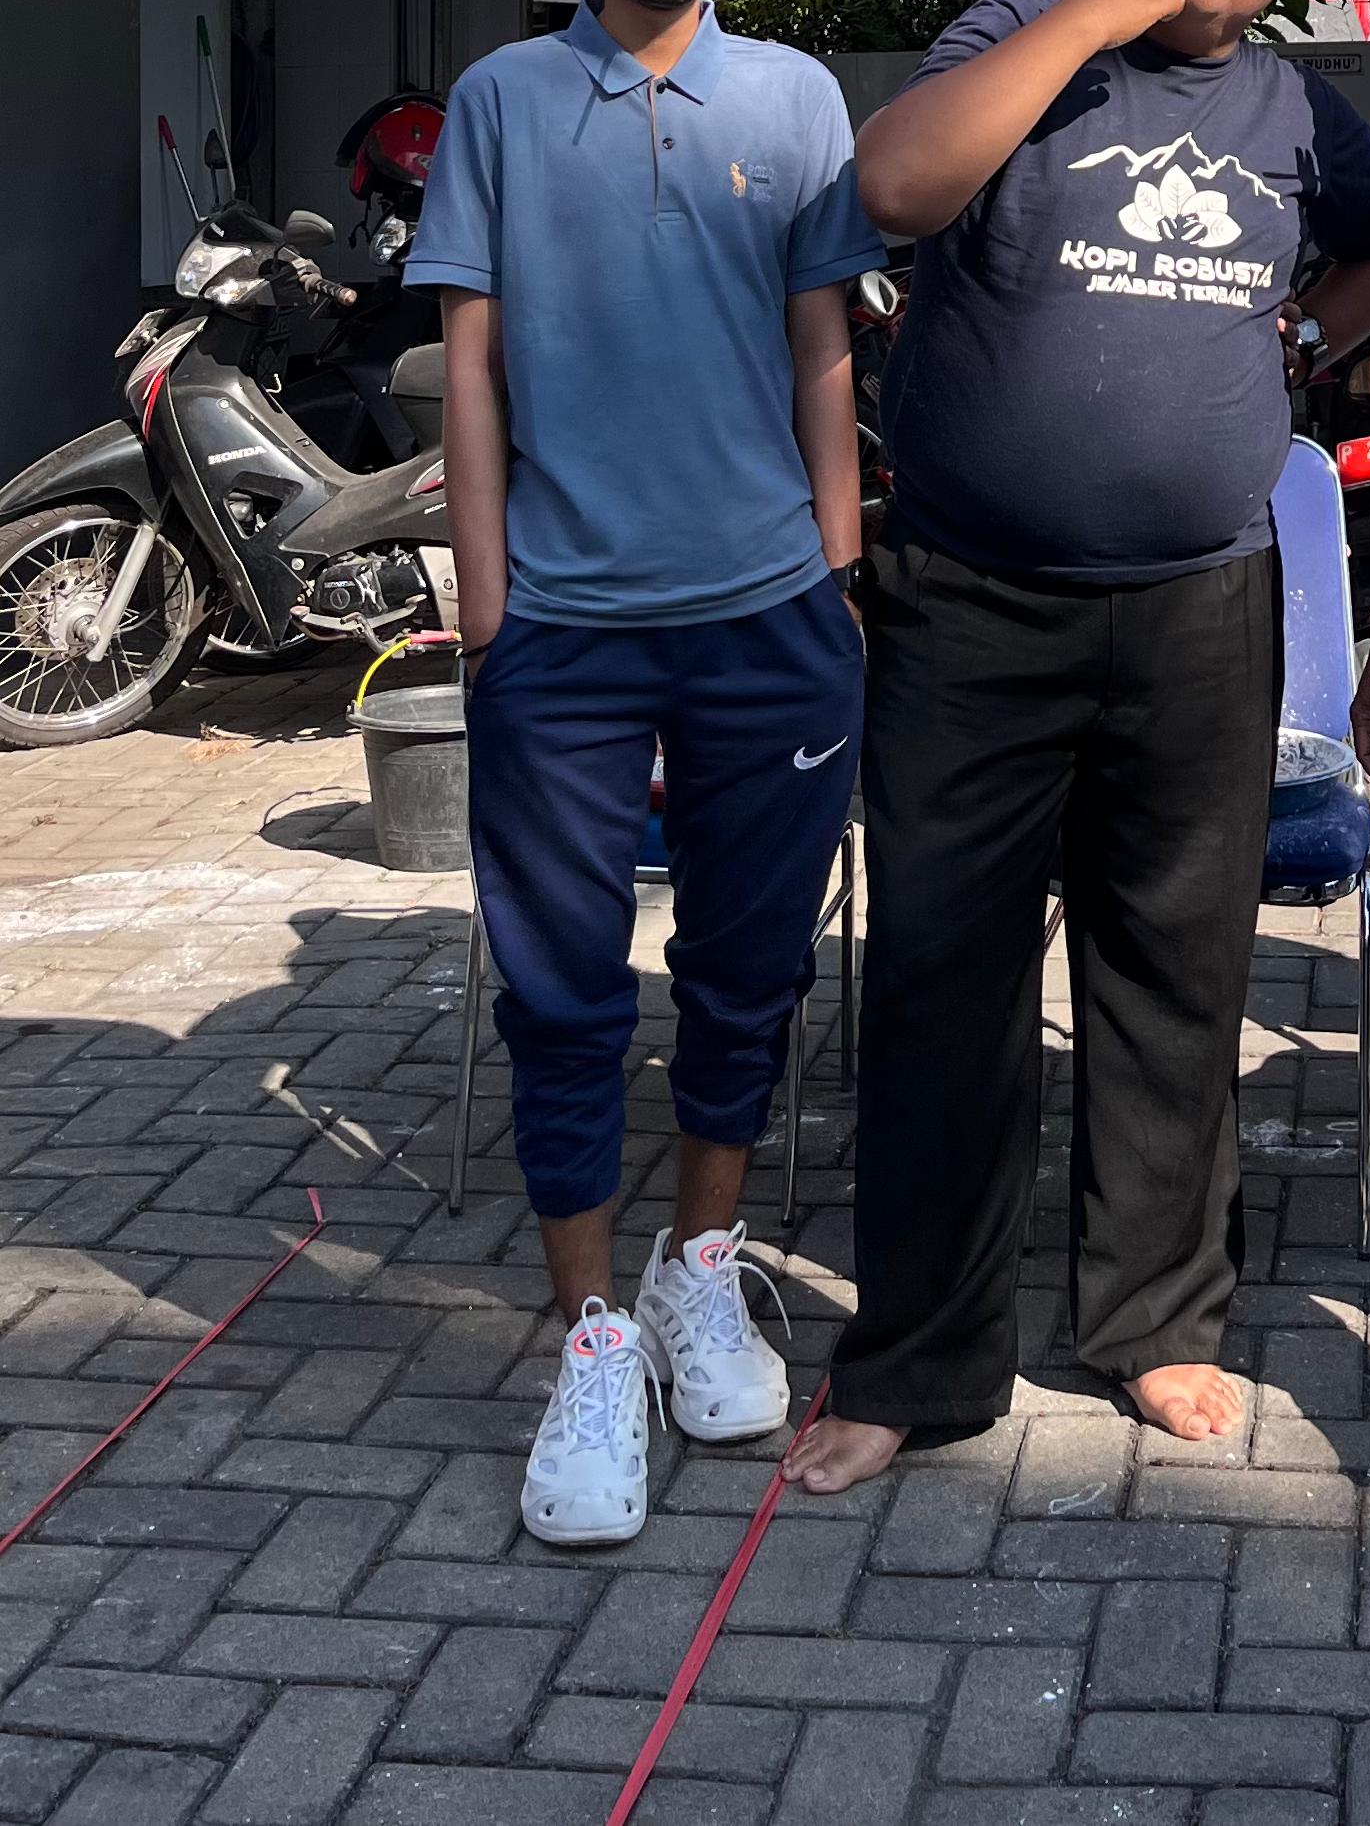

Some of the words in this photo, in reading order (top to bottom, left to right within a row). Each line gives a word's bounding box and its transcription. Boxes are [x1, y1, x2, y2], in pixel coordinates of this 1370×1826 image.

[1059, 239, 1138, 273] KOPI
[1153, 253, 1275, 289] ROBUSTA
[1086, 272, 1178, 301] JEMBER
[207, 445, 267, 465] HONDA
